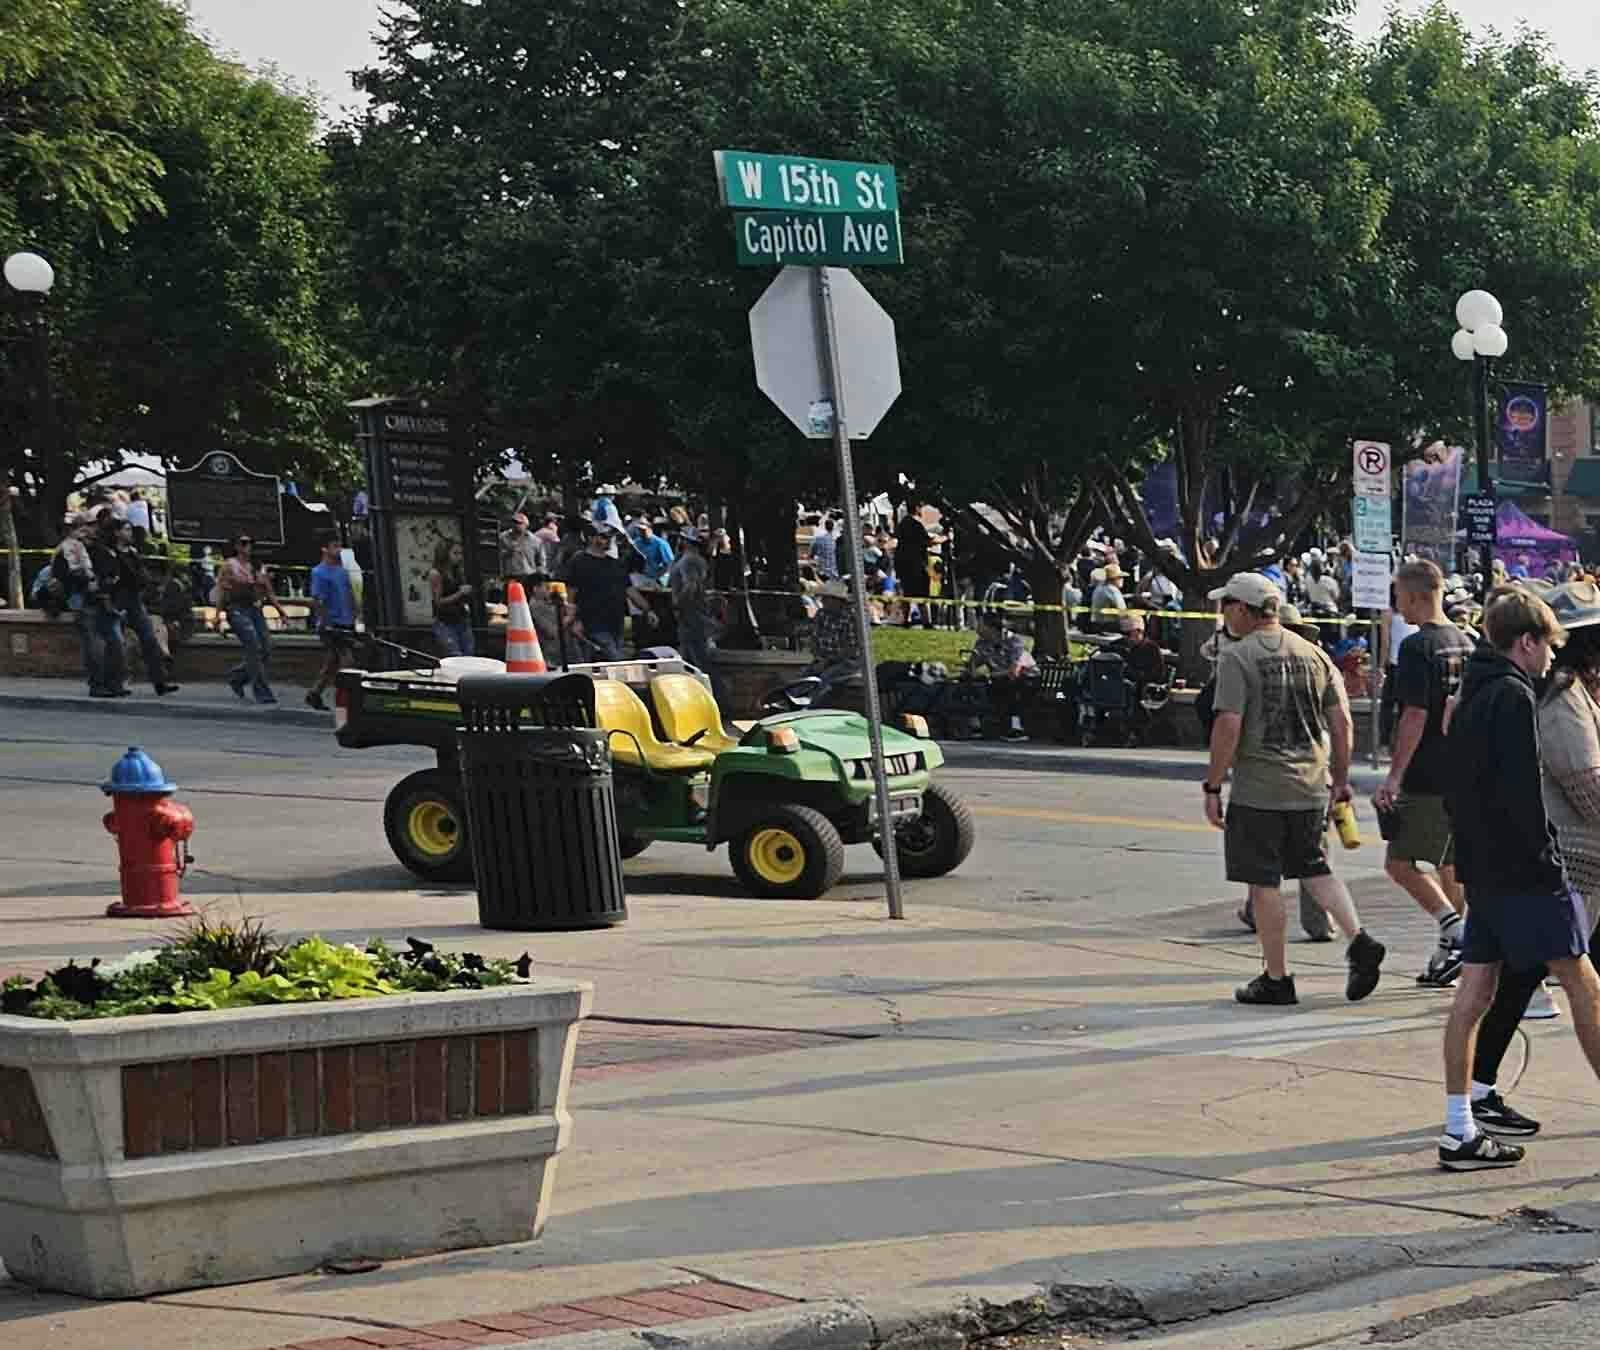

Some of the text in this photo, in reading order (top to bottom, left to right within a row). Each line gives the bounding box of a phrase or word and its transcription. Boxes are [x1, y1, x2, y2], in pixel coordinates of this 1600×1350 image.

[737, 160, 887, 210] W 15th St
[744, 215, 889, 263] Capitol Ave
